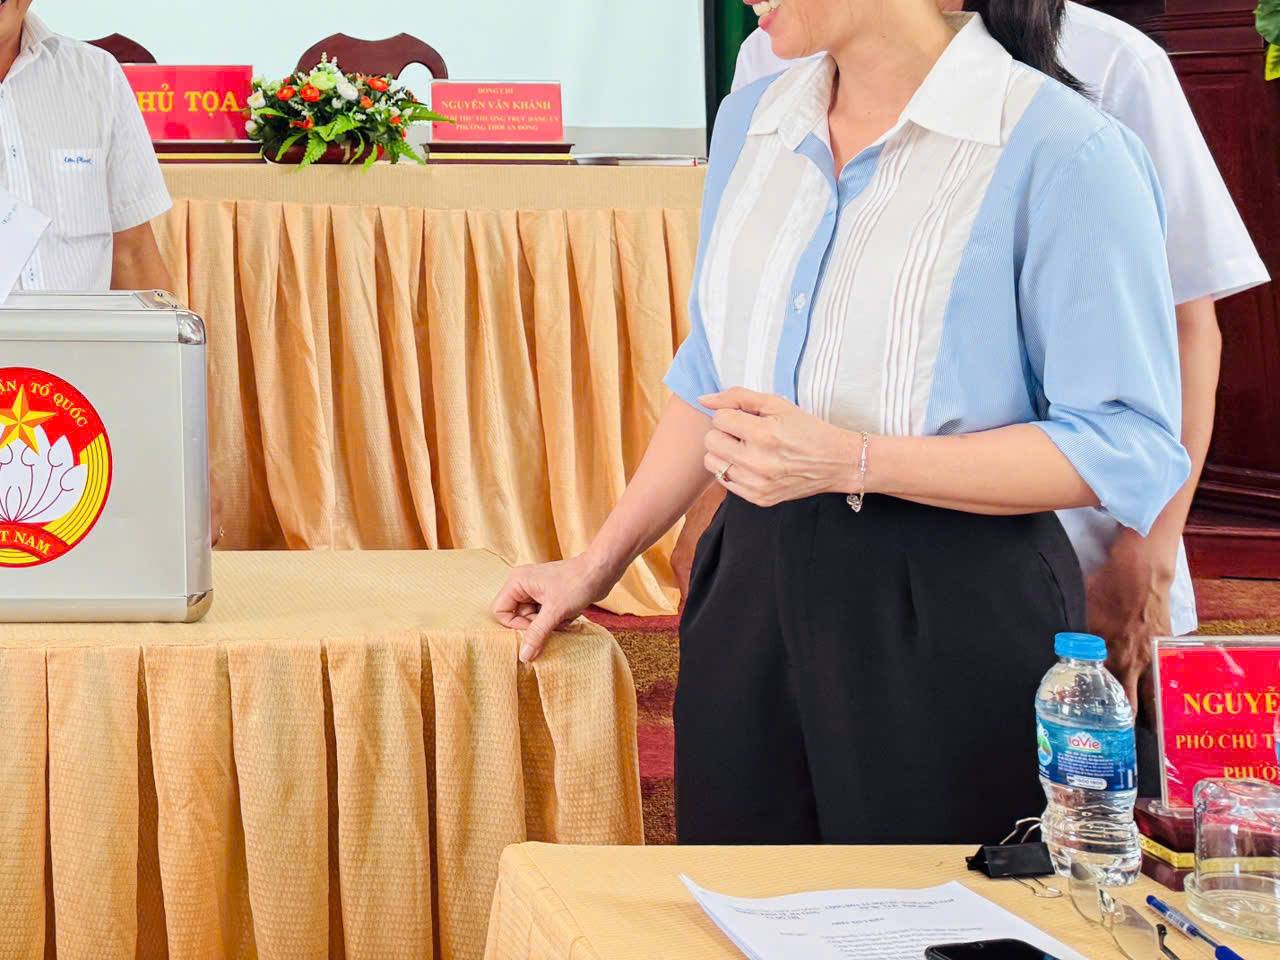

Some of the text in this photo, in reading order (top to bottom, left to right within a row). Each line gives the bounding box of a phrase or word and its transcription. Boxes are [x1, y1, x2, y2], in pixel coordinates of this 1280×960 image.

[135, 83, 240, 118] HỦ TỌA
[30, 382, 51, 397] TỔ
[53, 392, 89, 428] QUỐC
[13, 531, 52, 555] NAM
[1183, 686, 1280, 715] NGUYỄ
[1176, 730, 1214, 749] PHÓ
[1218, 730, 1257, 749] CHỦ
